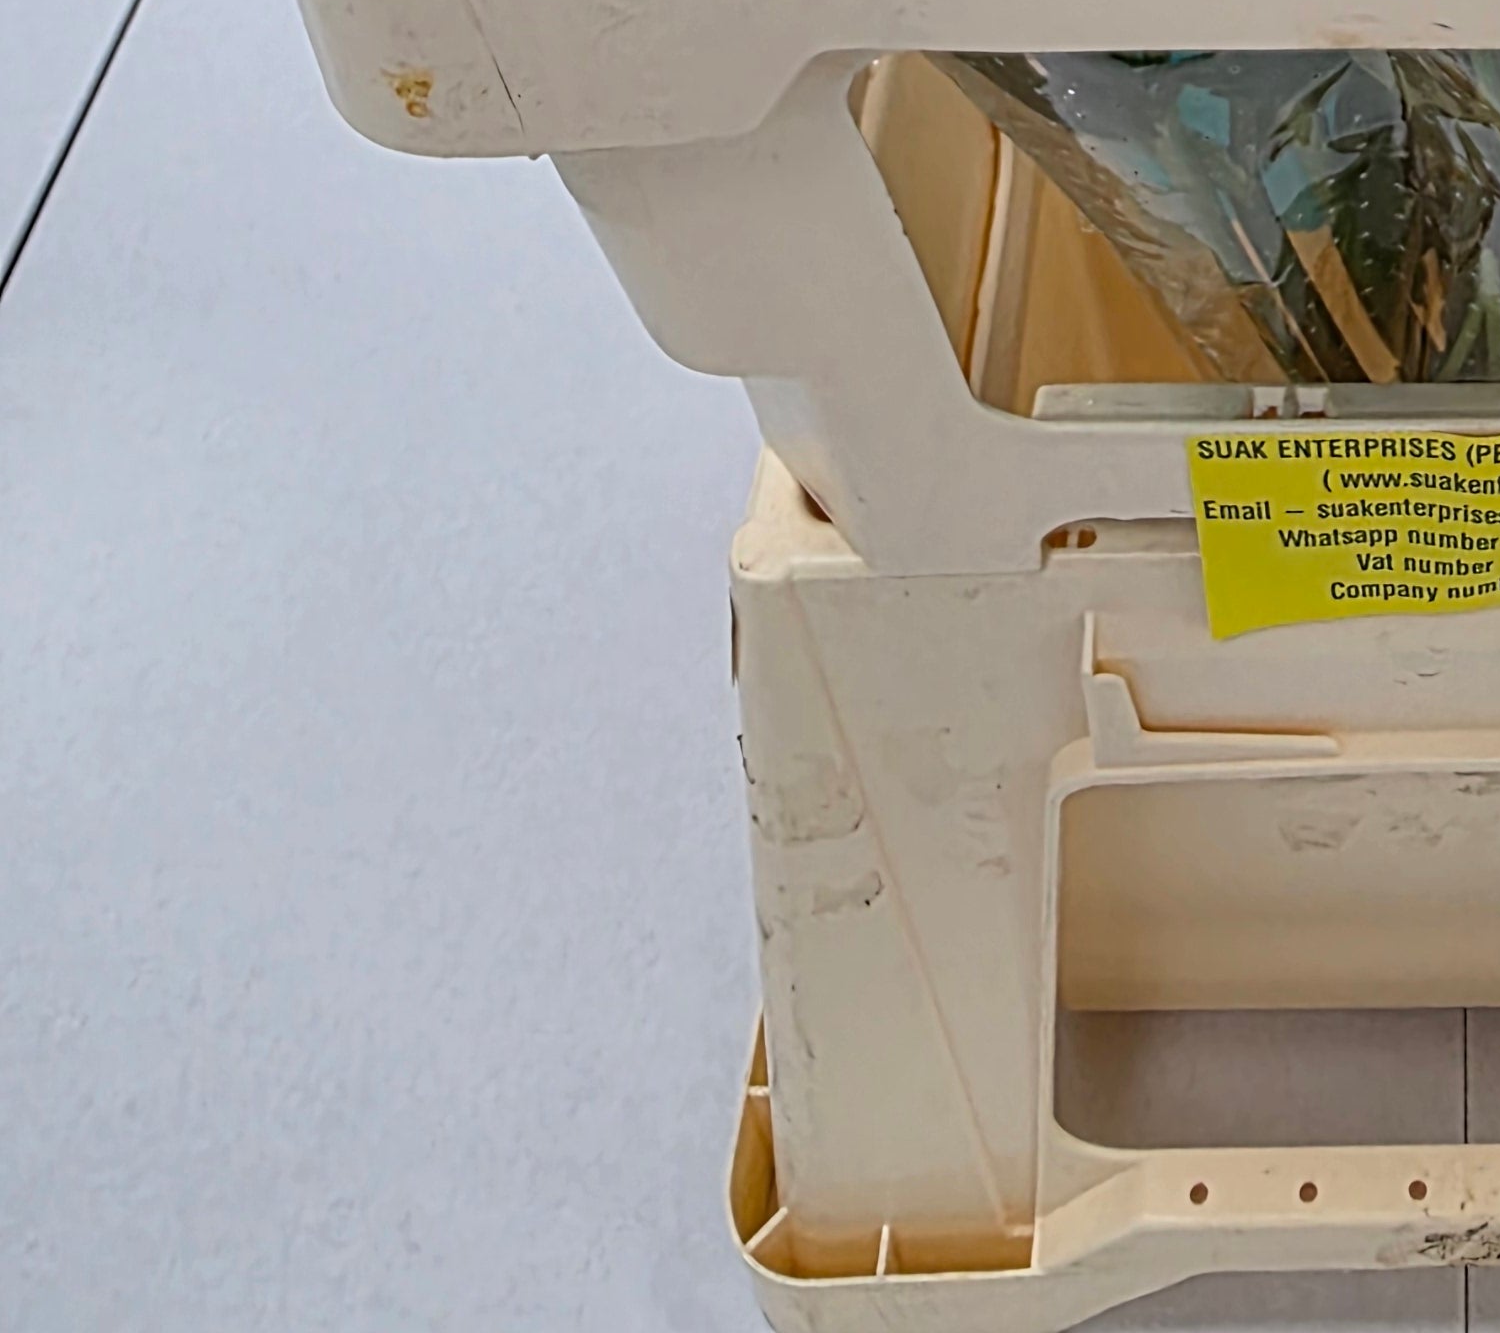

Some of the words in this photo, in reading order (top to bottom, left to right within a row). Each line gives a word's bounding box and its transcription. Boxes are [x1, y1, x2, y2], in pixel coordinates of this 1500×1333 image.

[1198, 440, 1268, 459] SUAK
[1279, 438, 1456, 461] ENTERPRISES
[1323, 469, 1331, 491] (
[1204, 501, 1271, 520] Email
[1279, 530, 1398, 547] Whatsapp
[1408, 530, 1499, 551] number
[1357, 554, 1393, 571] Vat
[1404, 556, 1493, 575] number
[1331, 582, 1438, 601] Company
